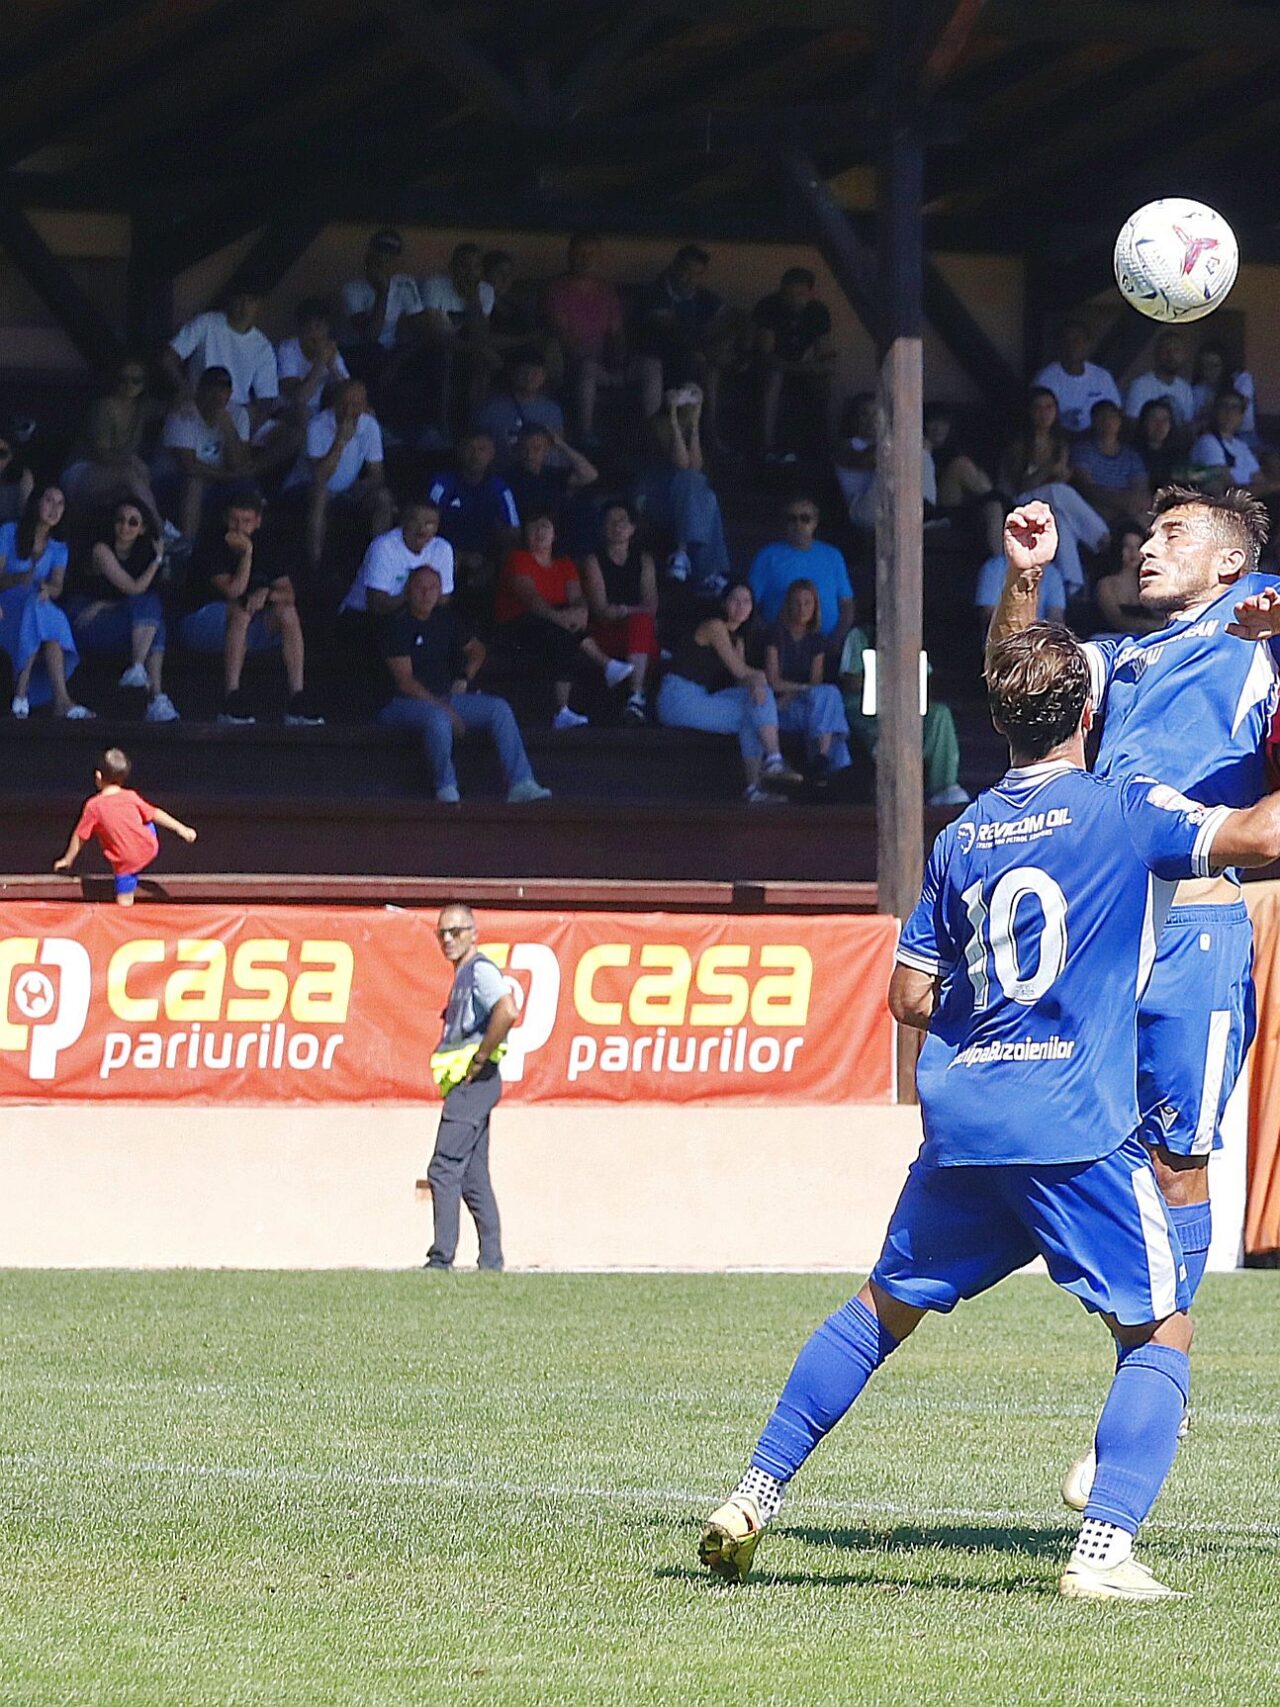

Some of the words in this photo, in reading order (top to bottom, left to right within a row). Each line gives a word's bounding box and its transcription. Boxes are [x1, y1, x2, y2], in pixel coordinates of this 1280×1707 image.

[976, 813, 1045, 842] REVICOM
[1046, 807, 1073, 828] OIL
[961, 866, 1069, 1010] 10
[107, 938, 355, 1024] casa
[573, 943, 813, 1027] casa
[100, 1023, 344, 1079] pariurilor
[567, 1027, 805, 1082] pariurilor
